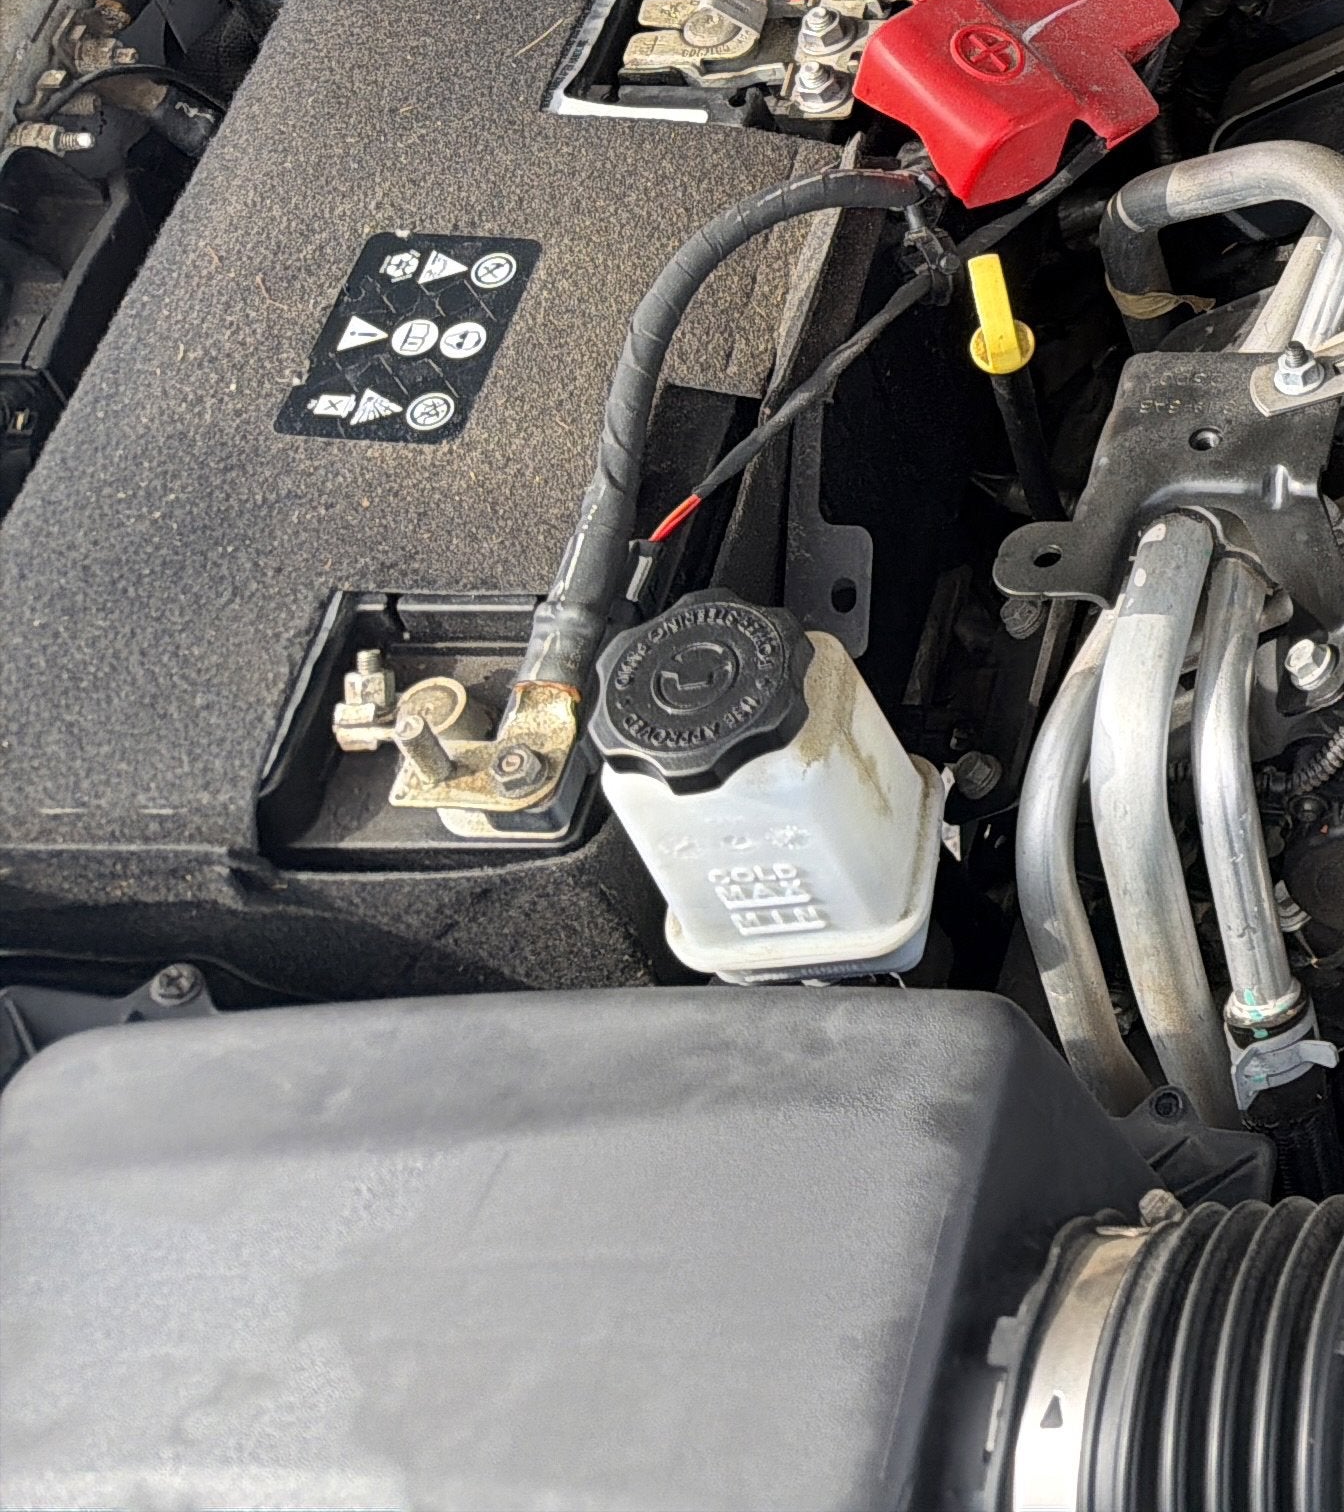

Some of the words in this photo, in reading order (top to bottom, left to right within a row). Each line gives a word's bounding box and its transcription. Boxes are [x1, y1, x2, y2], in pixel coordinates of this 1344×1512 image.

[622, 711, 721, 747] APPROVED
[708, 863, 798, 885] COLD
[715, 879, 811, 906] MAX
[731, 905, 820, 931] MIN
